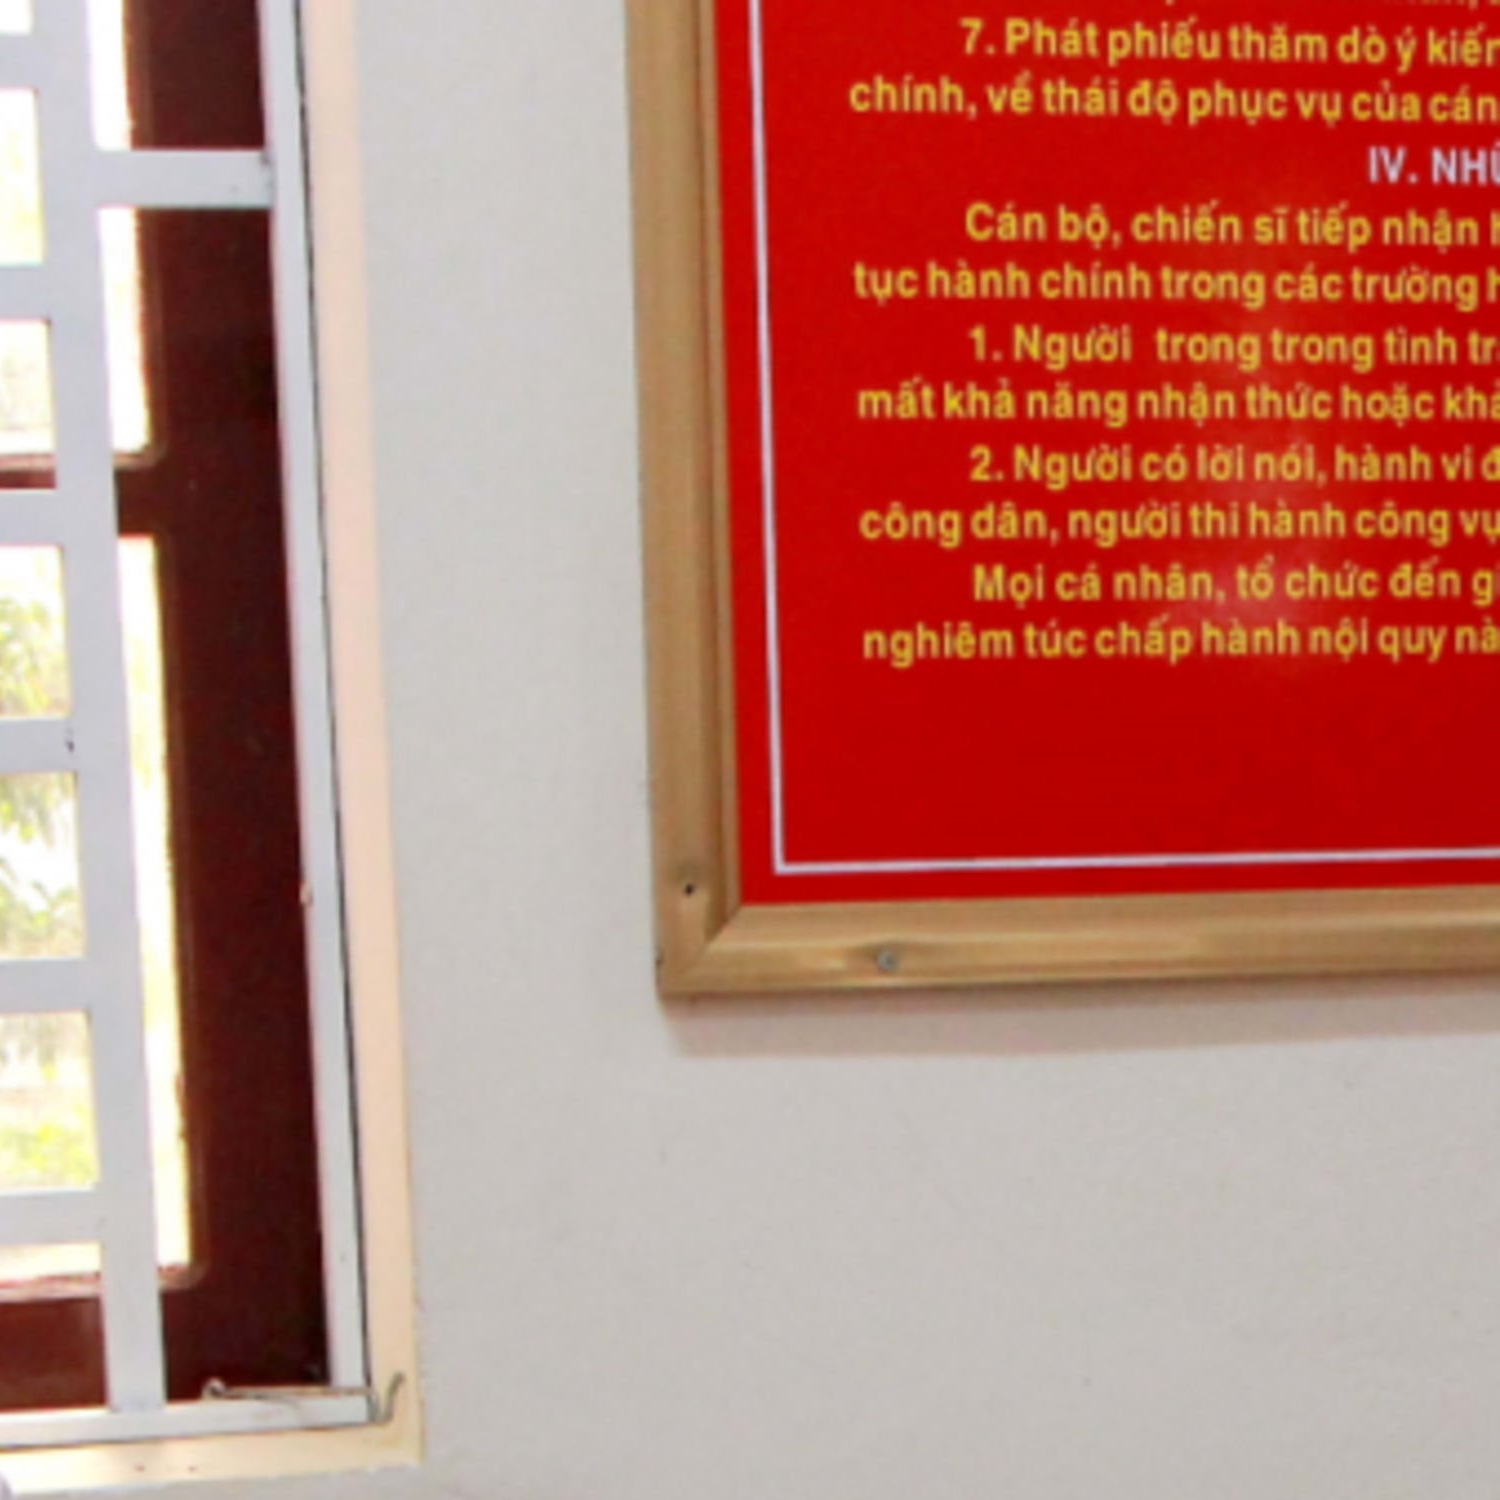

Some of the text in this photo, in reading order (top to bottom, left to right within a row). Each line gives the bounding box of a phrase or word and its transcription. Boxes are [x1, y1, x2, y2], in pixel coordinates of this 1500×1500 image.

[961, 18, 994, 54] 7.
[1006, 18, 1098, 57] Phát
[1108, 17, 1220, 66] phiếu
[1229, 25, 1327, 61] thăm
[1337, 27, 1387, 63] dò
[1396, 27, 1416, 72] ý
[850, 71, 1499, 125] chính, về thái độ phục vụ của cán
[1370, 147, 1417, 183] IV.
[966, 202, 1046, 240] Cán
[1059, 204, 1120, 248] bộ,
[1132, 200, 1242, 243] chiến
[1254, 207, 1288, 244] sĩ
[1296, 203, 1371, 253] tiếp
[1383, 210, 1478, 251] nhận
[854, 263, 917, 302] tục
[928, 262, 1029, 298] hành
[1040, 262, 1151, 298] chính
[1161, 266, 1265, 310] trong
[1274, 264, 1342, 301] các
[1351, 266, 1478, 312] trường
[971, 325, 1500, 373] 1. Người trong trong tình tr
[859, 377, 934, 418] mất
[944, 378, 1015, 418] khả
[1027, 383, 1127, 428] năng
[1138, 382, 1236, 426] nhận
[1245, 382, 1331, 419] thức
[1341, 385, 1433, 426] hoặc
[971, 445, 1003, 481] 2.
[1014, 445, 1131, 490] Người
[1141, 444, 1188, 481] có
[1197, 444, 1245, 481] lời
[1254, 444, 1326, 484] nói,
[1335, 445, 1431, 481] hành
[1442, 446, 1472, 480] vi
[860, 502, 961, 548] công
[971, 502, 1057, 541] dân,
[1069, 502, 1180, 547] người
[1189, 502, 1239, 537] thi
[1248, 498, 1345, 538] hành
[1355, 502, 1449, 546] công
[974, 564, 1043, 606] Mọi
[1056, 564, 1100, 600] cá
[1114, 563, 1226, 605] nhân,
[1235, 554, 1275, 602] tổ
[1284, 562, 1378, 600] chức
[1389, 558, 1460, 597] đến
[864, 622, 1013, 668] nghiêm
[1024, 621, 1085, 657] túc
[1095, 614, 1193, 663] chấp
[1201, 617, 1300, 655] hành
[1309, 618, 1368, 659] nội
[1378, 627, 1446, 664] quy
